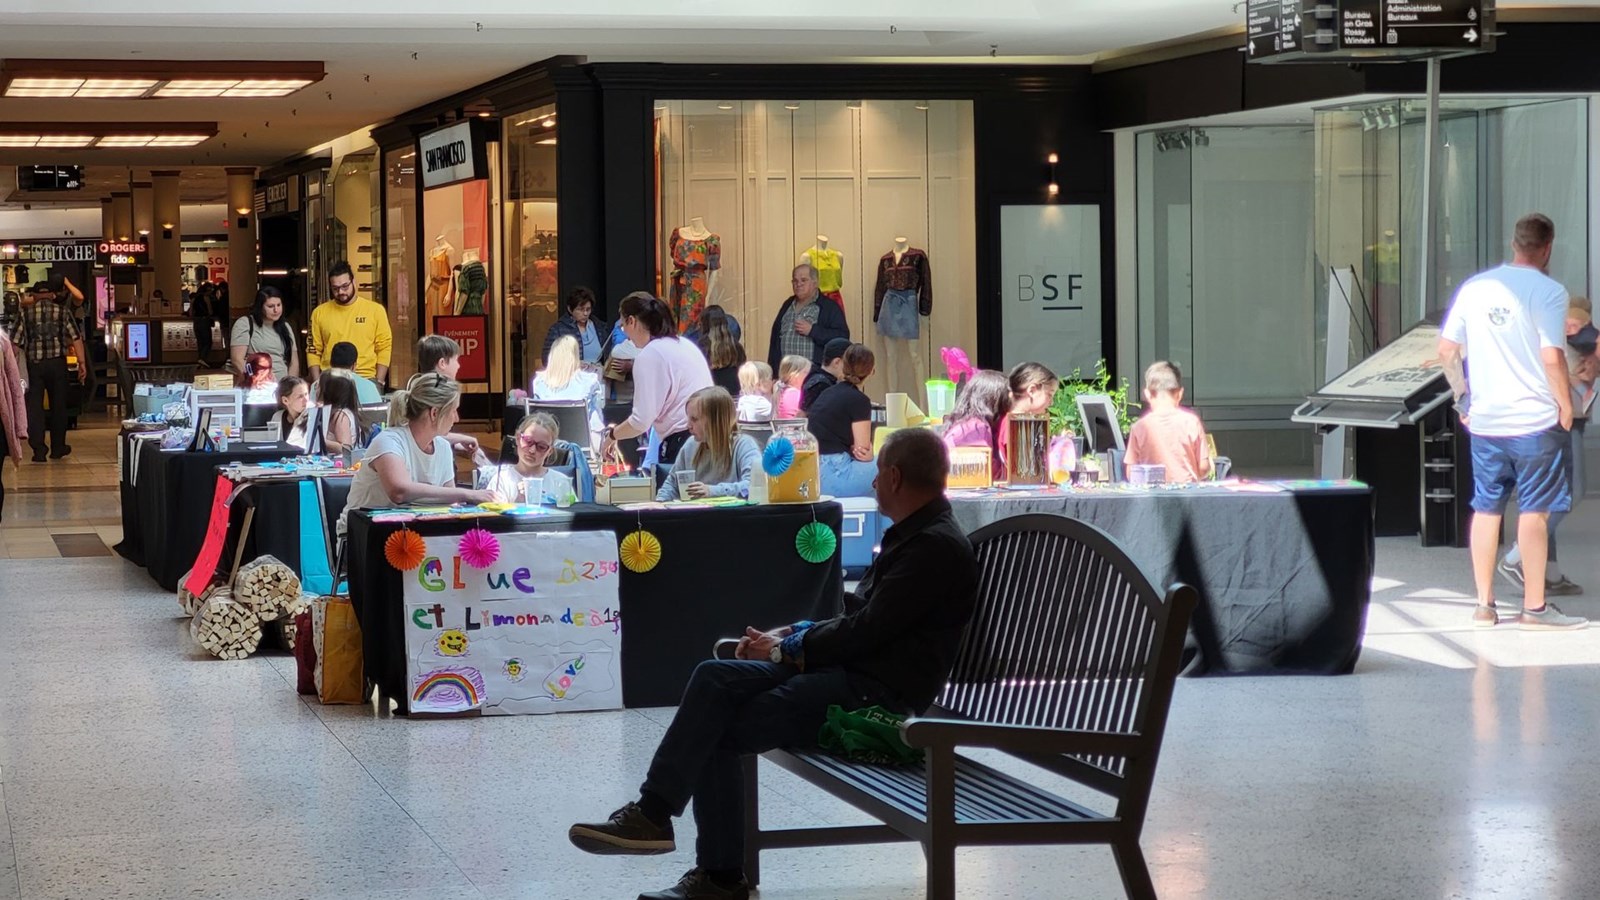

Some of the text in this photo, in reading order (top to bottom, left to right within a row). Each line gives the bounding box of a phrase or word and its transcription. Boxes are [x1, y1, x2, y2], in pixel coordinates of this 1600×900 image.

[1387, 4, 1442, 12] Administration
[1344, 11, 1371, 19] Bureau
[1387, 13, 1418, 21] Bureaux
[1355, 20, 1374, 28] Gros
[1344, 29, 1367, 37] Rossy
[1344, 37, 1376, 45] Winners
[436, 139, 466, 170] FRANCISCO
[109, 243, 146, 253] ROGERS
[34, 244, 95, 261] STITCHE
[110, 254, 128, 264] fido
[208, 257, 228, 265] SOL
[1018, 274, 1083, 301] BSF
[355, 316, 366, 324] CAT
[455, 338, 479, 356] IP
[412, 603, 445, 630] et
